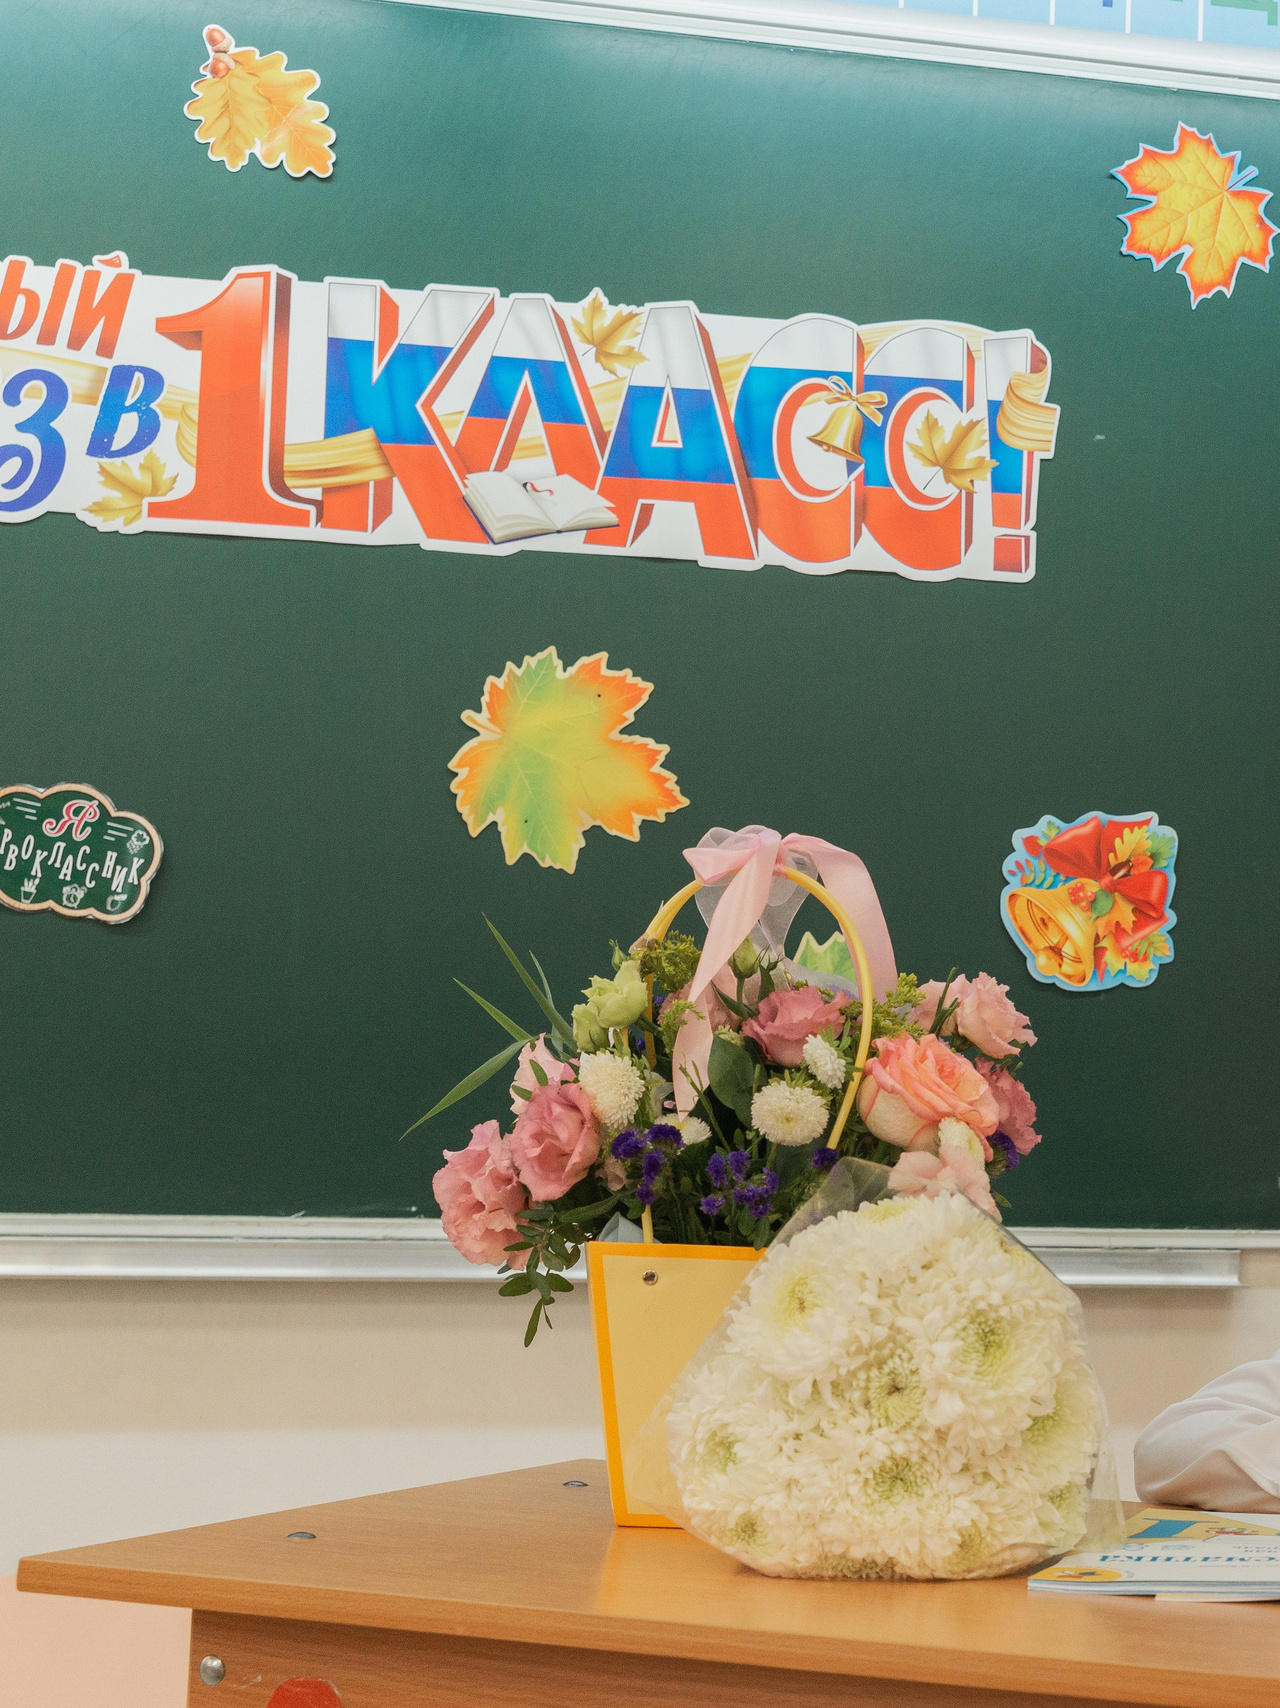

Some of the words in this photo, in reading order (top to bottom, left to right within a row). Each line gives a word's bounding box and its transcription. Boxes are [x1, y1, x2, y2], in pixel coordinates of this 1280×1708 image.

[145, 270, 325, 529] 1
[321, 281, 1043, 574] КЛАСС!
[42, 799, 100, 842] Я
